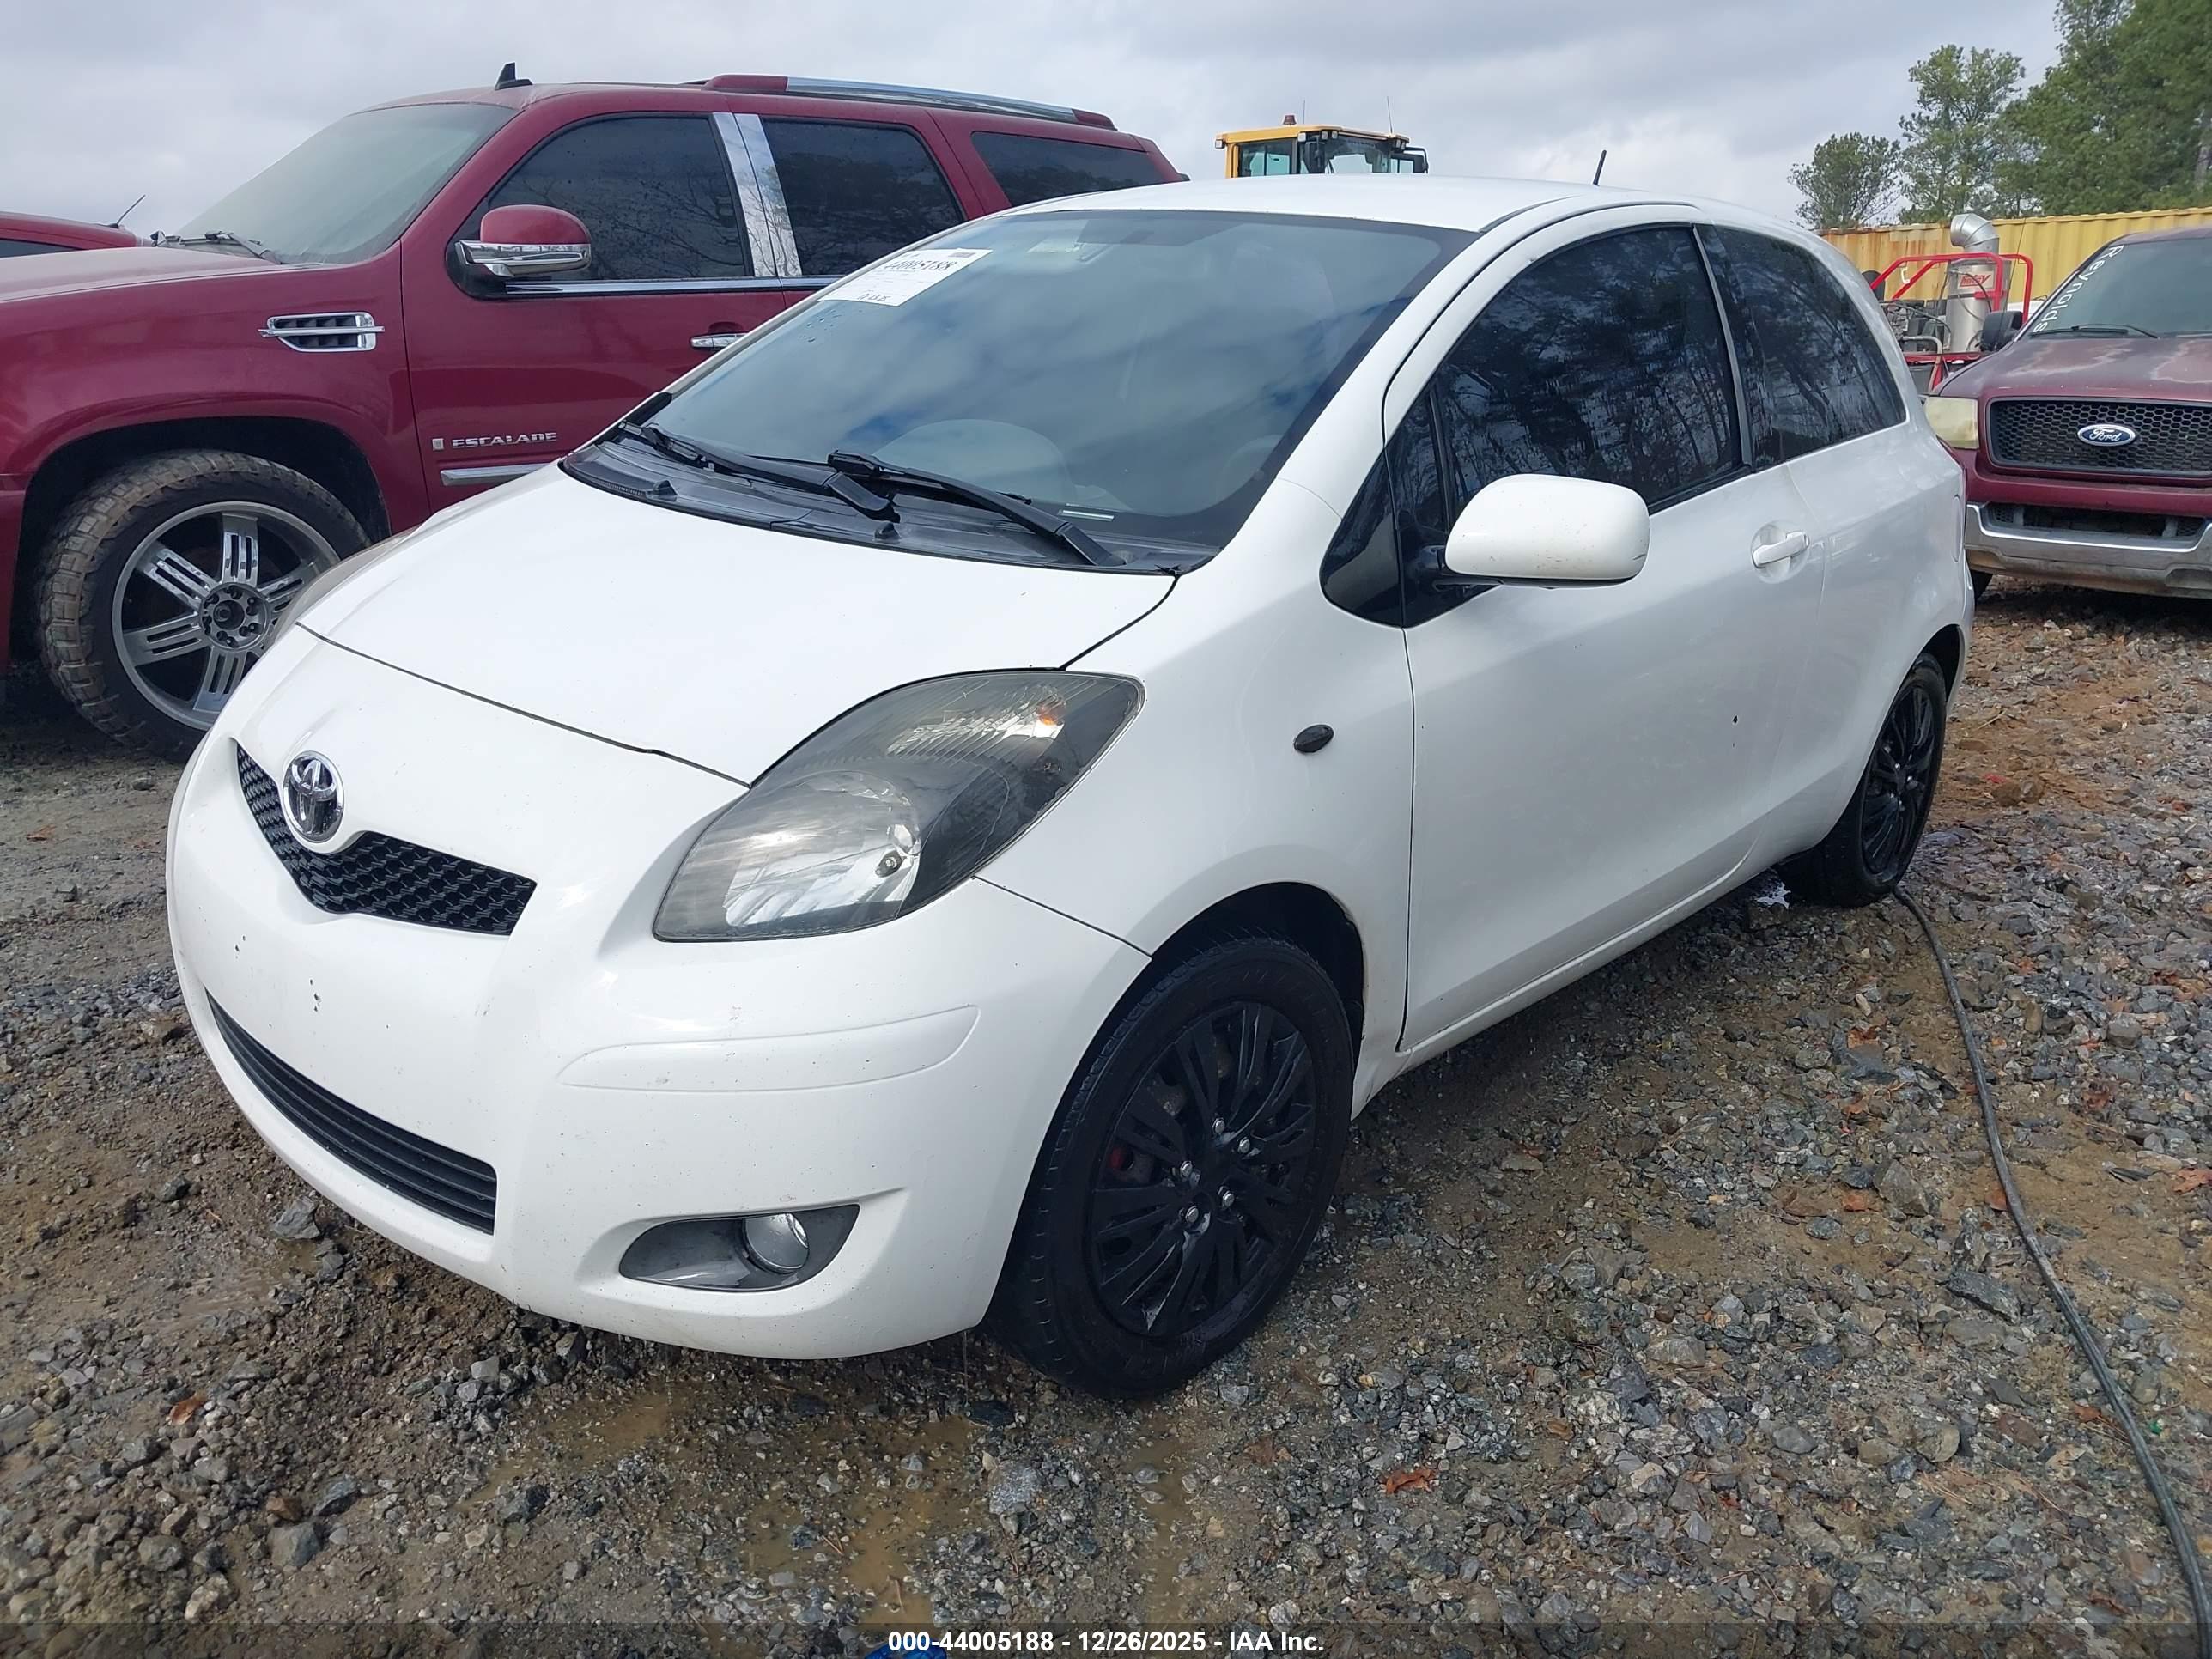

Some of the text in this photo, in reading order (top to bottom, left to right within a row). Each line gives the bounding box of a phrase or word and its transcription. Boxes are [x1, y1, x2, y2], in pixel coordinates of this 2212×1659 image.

[2033, 243, 2124, 333] Reynolds
[452, 432, 557, 449] ESCALADE
[2089, 428, 2122, 442] Ford
